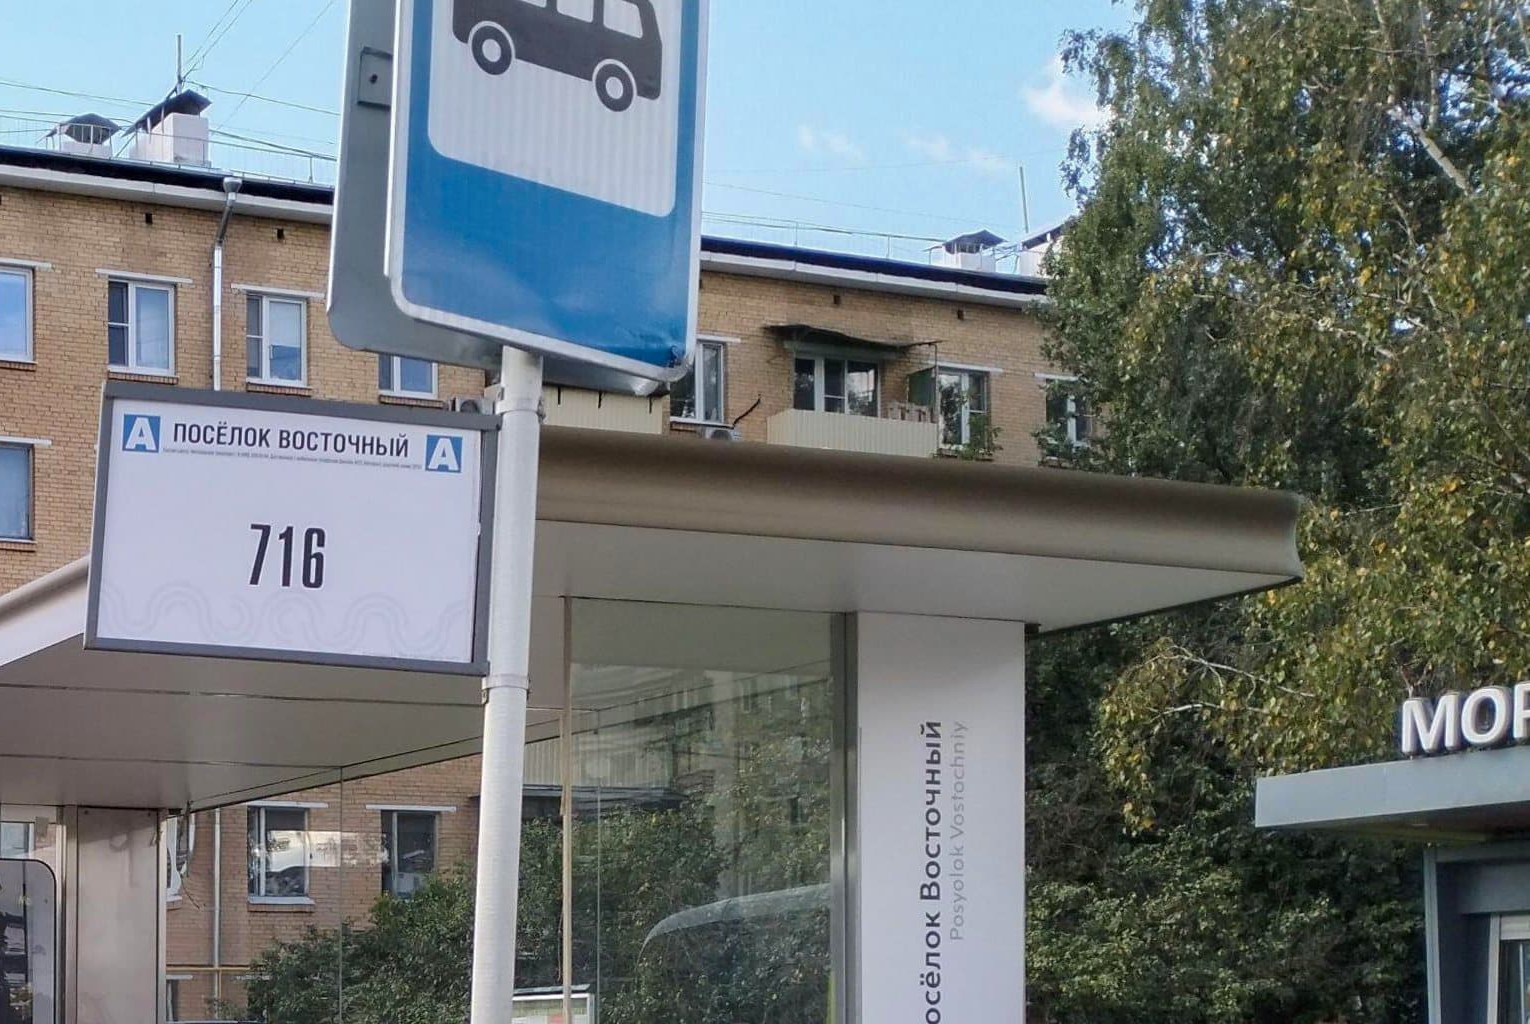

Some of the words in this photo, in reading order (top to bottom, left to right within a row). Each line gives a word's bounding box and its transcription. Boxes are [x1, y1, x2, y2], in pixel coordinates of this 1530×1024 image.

[173, 420, 270, 448] ПОСЁЛОК
[278, 429, 409, 458] ВОСТОЧНЫЙ
[249, 523, 326, 589] 716
[920, 720, 942, 900] Восточный
[950, 720, 969, 840] Vostochniy
[950, 845, 968, 941] Posyolok
